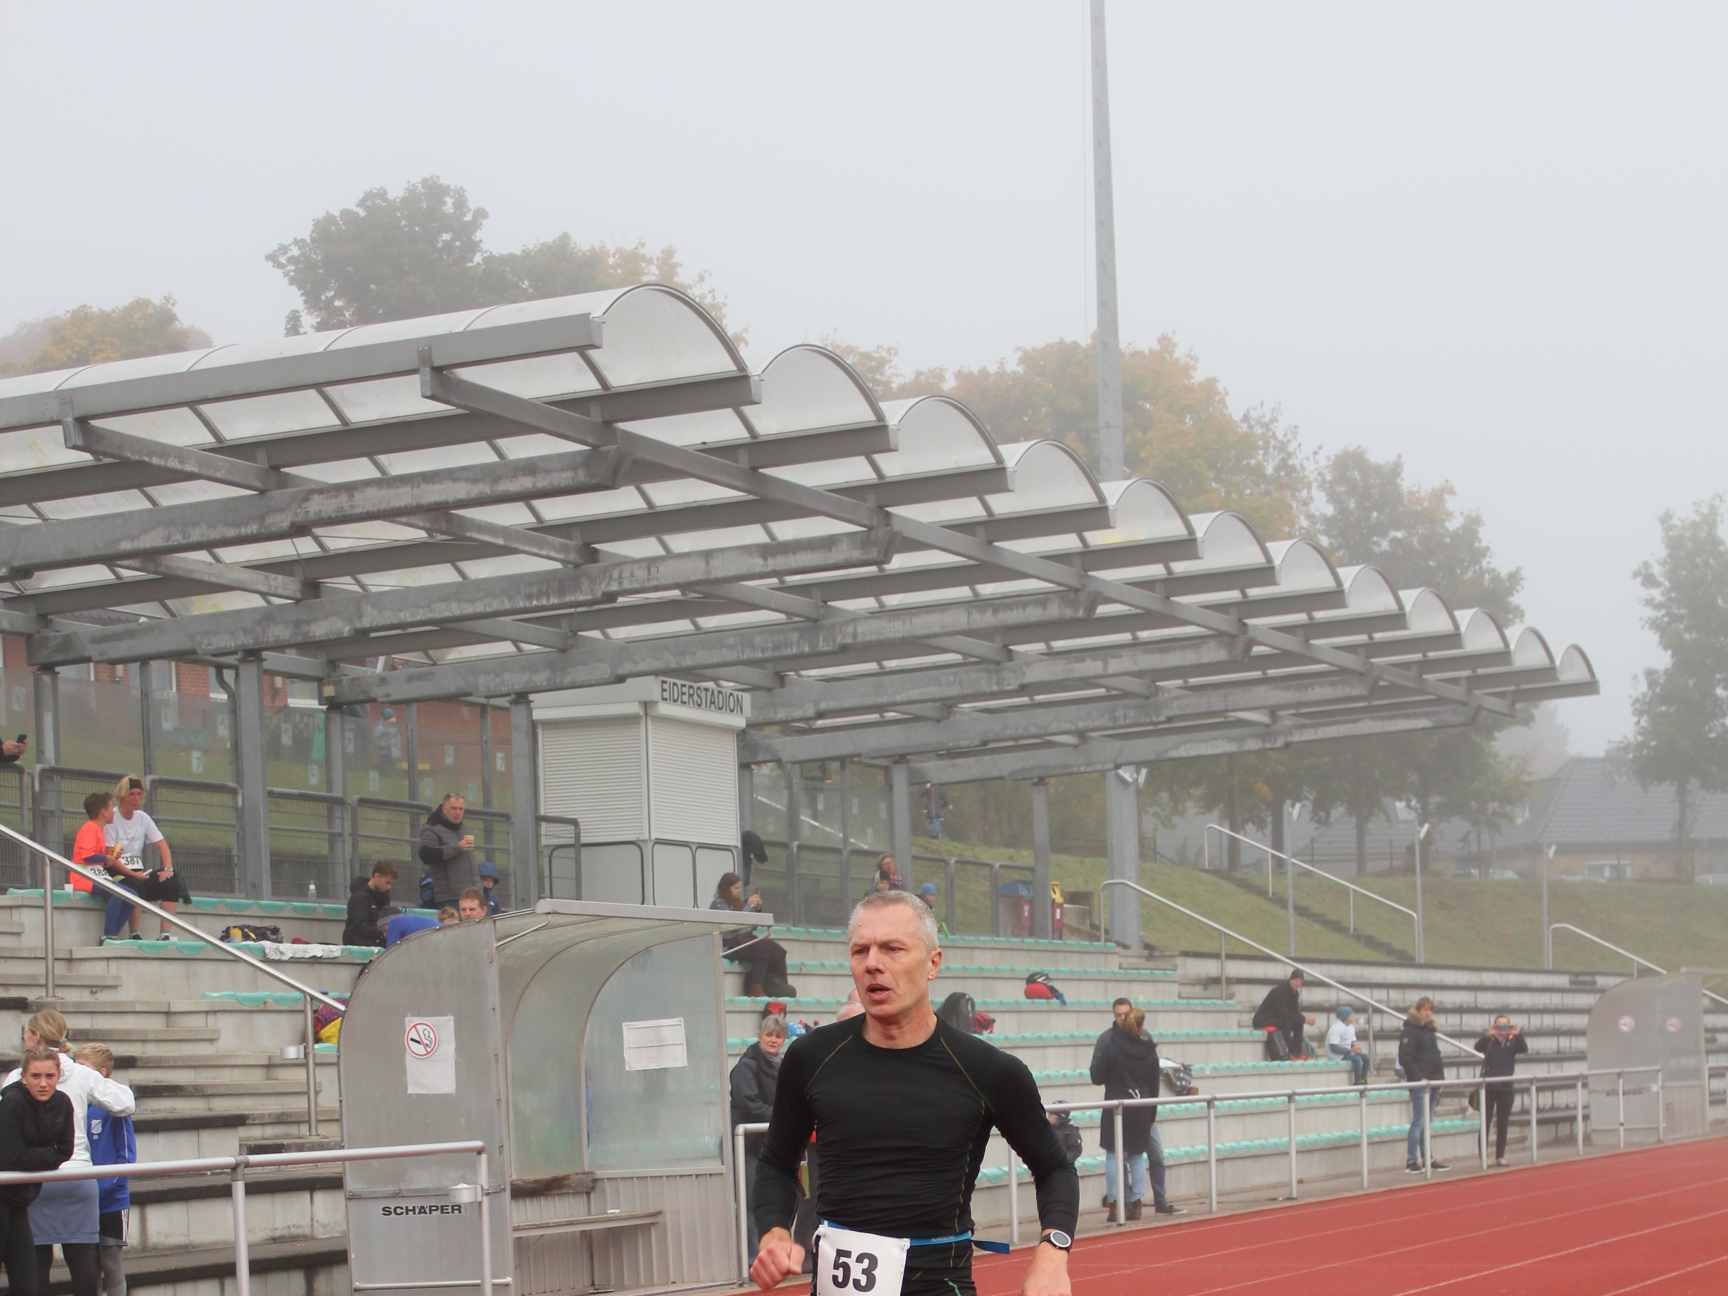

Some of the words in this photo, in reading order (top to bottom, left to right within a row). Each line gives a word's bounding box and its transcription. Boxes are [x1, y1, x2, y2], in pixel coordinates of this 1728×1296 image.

[660, 679, 744, 715] EIDERSTADION
[381, 1204, 462, 1216] SCHÄPER
[831, 1248, 879, 1293] 53
